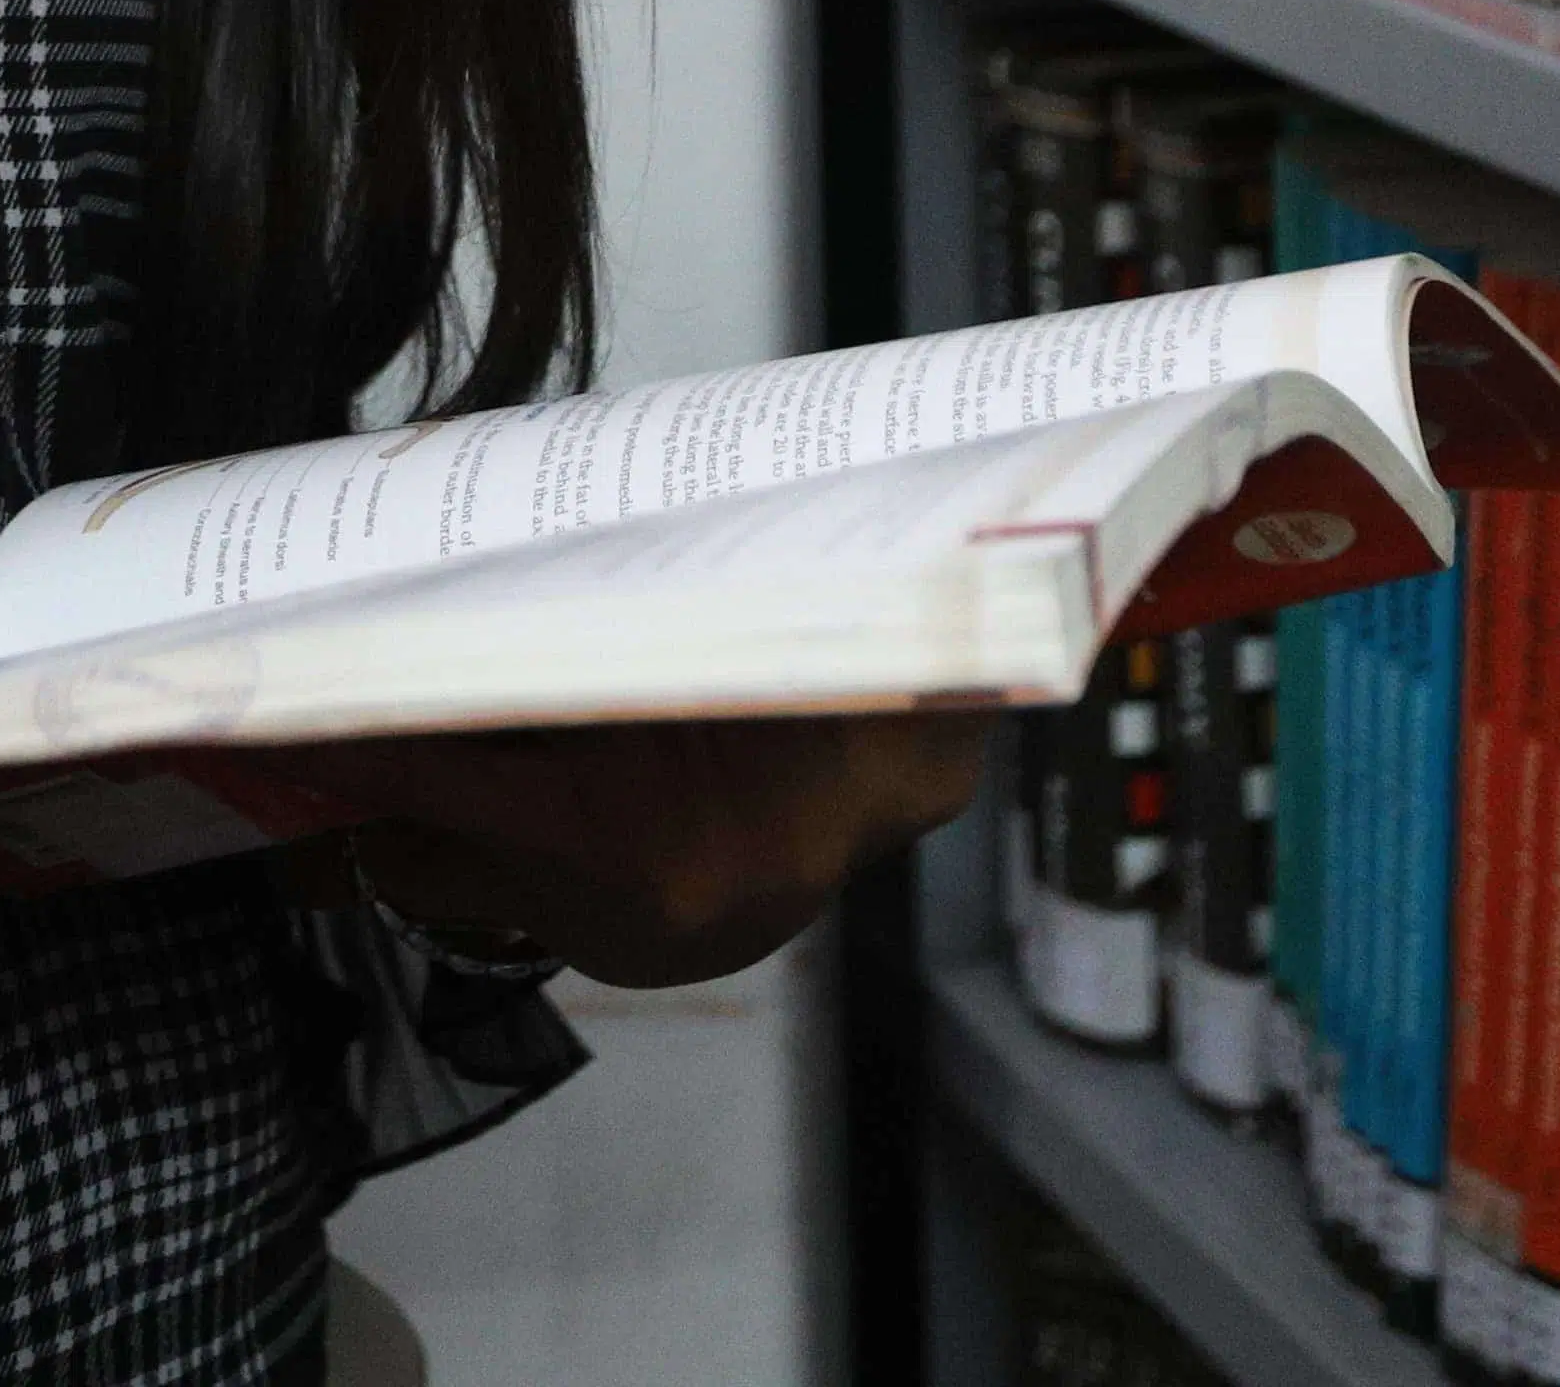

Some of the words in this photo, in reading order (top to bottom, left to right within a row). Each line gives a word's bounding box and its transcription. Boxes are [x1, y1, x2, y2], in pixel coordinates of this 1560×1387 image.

[1162, 329, 1178, 352] and
[1209, 327, 1224, 352] run
[1107, 356, 1131, 387] (Fig.
[1161, 357, 1178, 384] the
[906, 389, 927, 437] (nerve
[952, 397, 970, 421] the
[725, 415, 748, 452] along
[885, 401, 903, 454] surface
[537, 430, 561, 466] medial
[664, 446, 681, 468] the
[680, 435, 703, 474] along
[794, 436, 809, 459] the
[816, 439, 832, 467] and
[535, 469, 551, 484] to
[577, 460, 594, 482] the
[728, 455, 744, 480] the
[772, 461, 786, 477] to
[441, 471, 463, 505] outer
[460, 444, 495, 524] continuation
[553, 461, 575, 517] behind
[576, 485, 591, 505] fat
[532, 487, 548, 511] the
[439, 509, 459, 556] borde
[575, 511, 589, 528] of
[327, 518, 344, 562] anterior
[460, 530, 476, 547] of
[237, 539, 254, 586] serratus
[274, 541, 290, 571] dorsi
[212, 581, 229, 606] and
